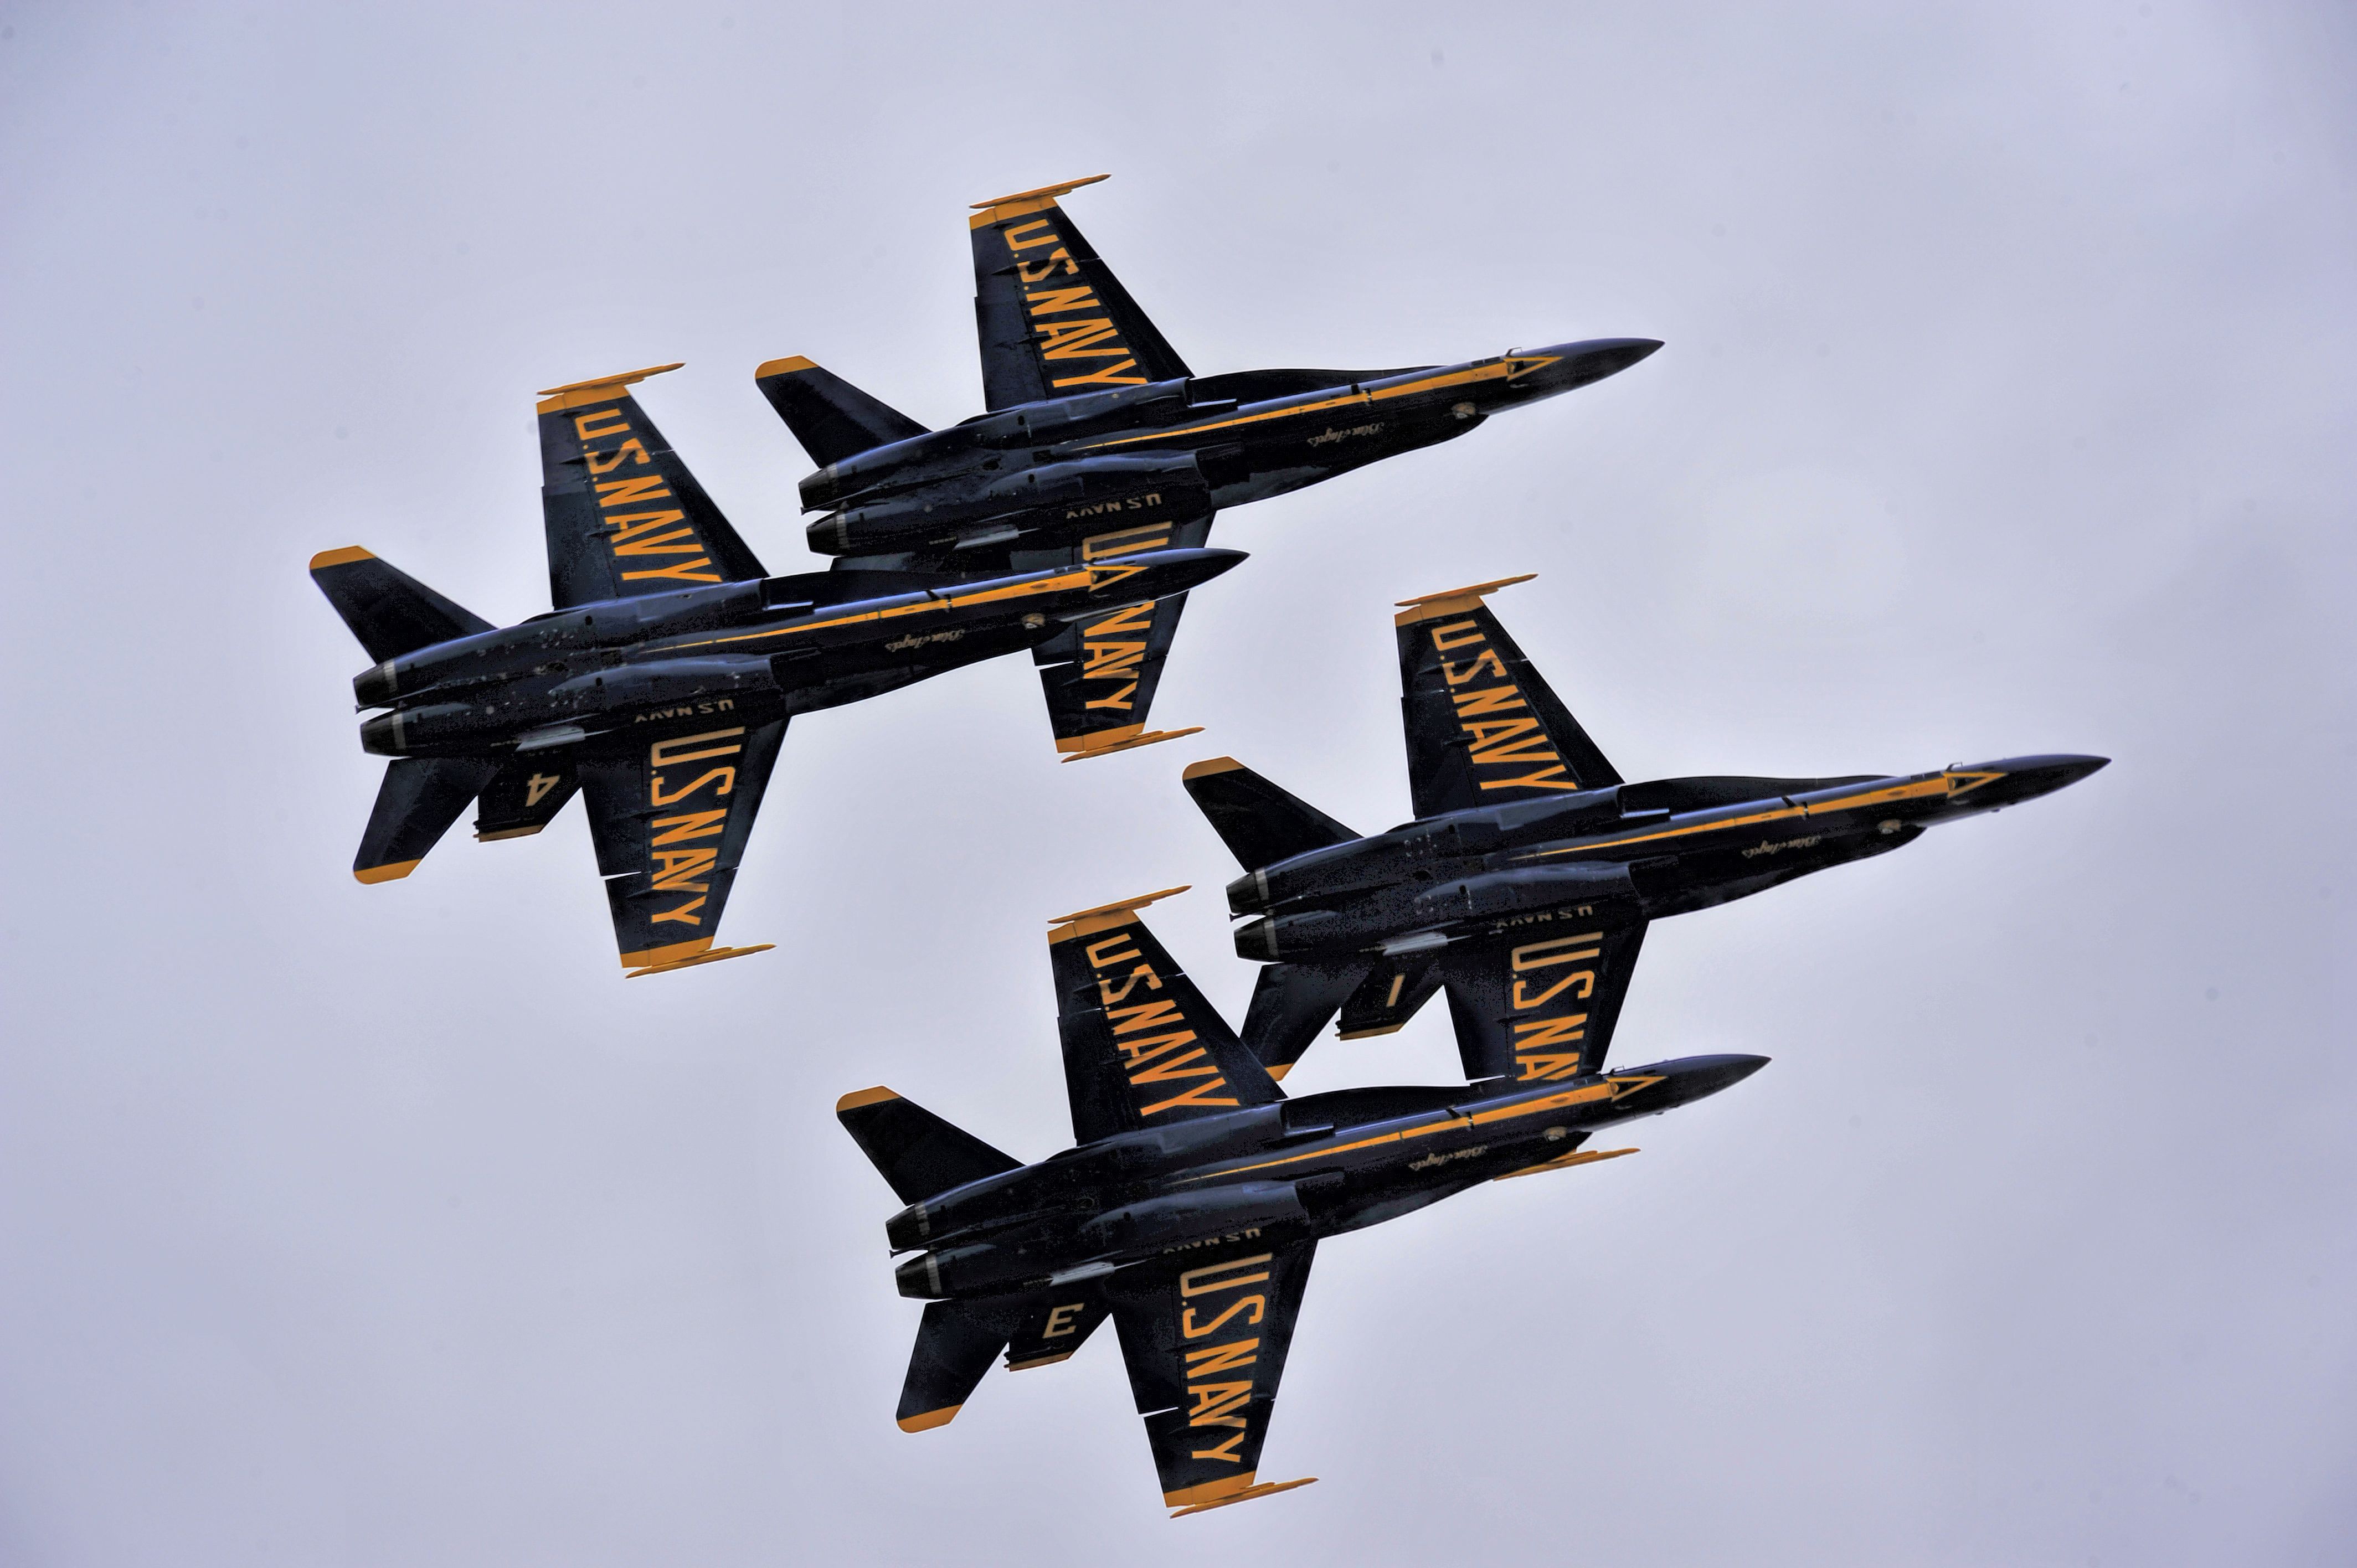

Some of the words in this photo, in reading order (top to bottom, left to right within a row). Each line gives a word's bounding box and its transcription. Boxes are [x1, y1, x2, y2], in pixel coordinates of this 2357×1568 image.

[1026, 285, 1149, 388] NAVY
[594, 474, 723, 582] NAVY
[1066, 501, 1123, 519] NAVY
[1083, 600, 1156, 710] NAVY
[635, 706, 693, 723] NAVY
[1452, 684, 1578, 790] NAVY
[526, 772, 560, 807] 4
[651, 808, 727, 926] NAVY
[1106, 999, 1240, 1117] NAVY
[1514, 1013, 1588, 1081] NA
[1185, 1337, 1260, 1463] NAVY
